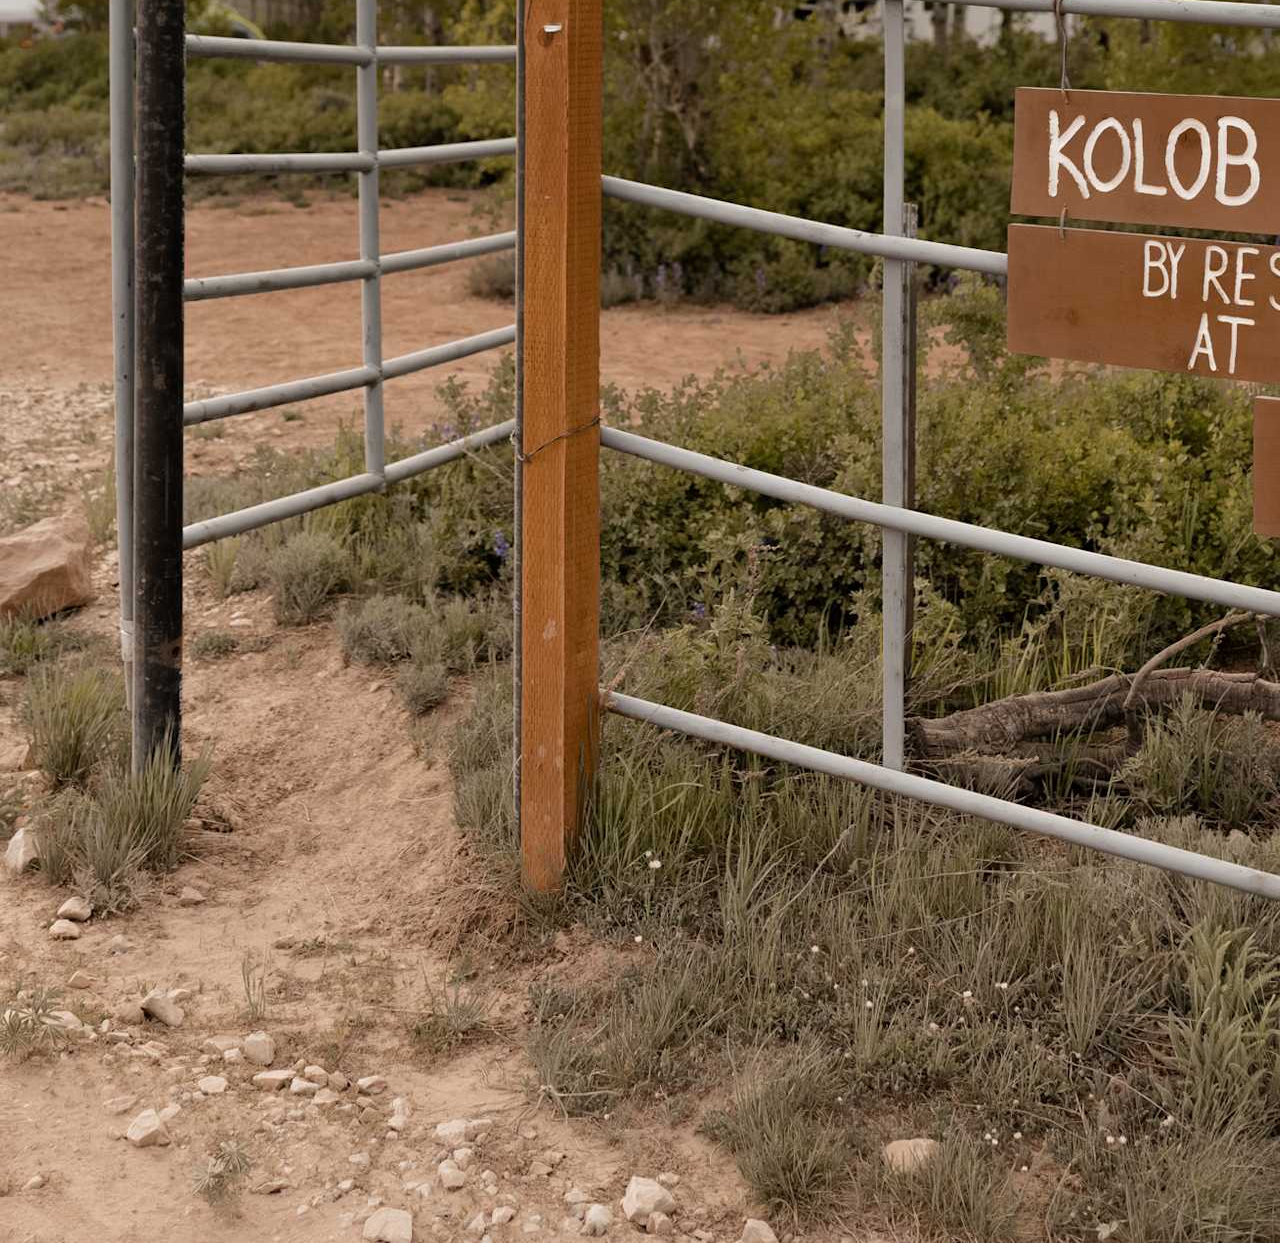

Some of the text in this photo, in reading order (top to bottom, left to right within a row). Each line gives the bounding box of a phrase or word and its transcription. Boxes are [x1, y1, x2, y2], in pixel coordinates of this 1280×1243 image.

[1047, 109, 1261, 207] KOLOB
[1142, 240, 1186, 299] BY
[1187, 313, 1255, 374] AT
